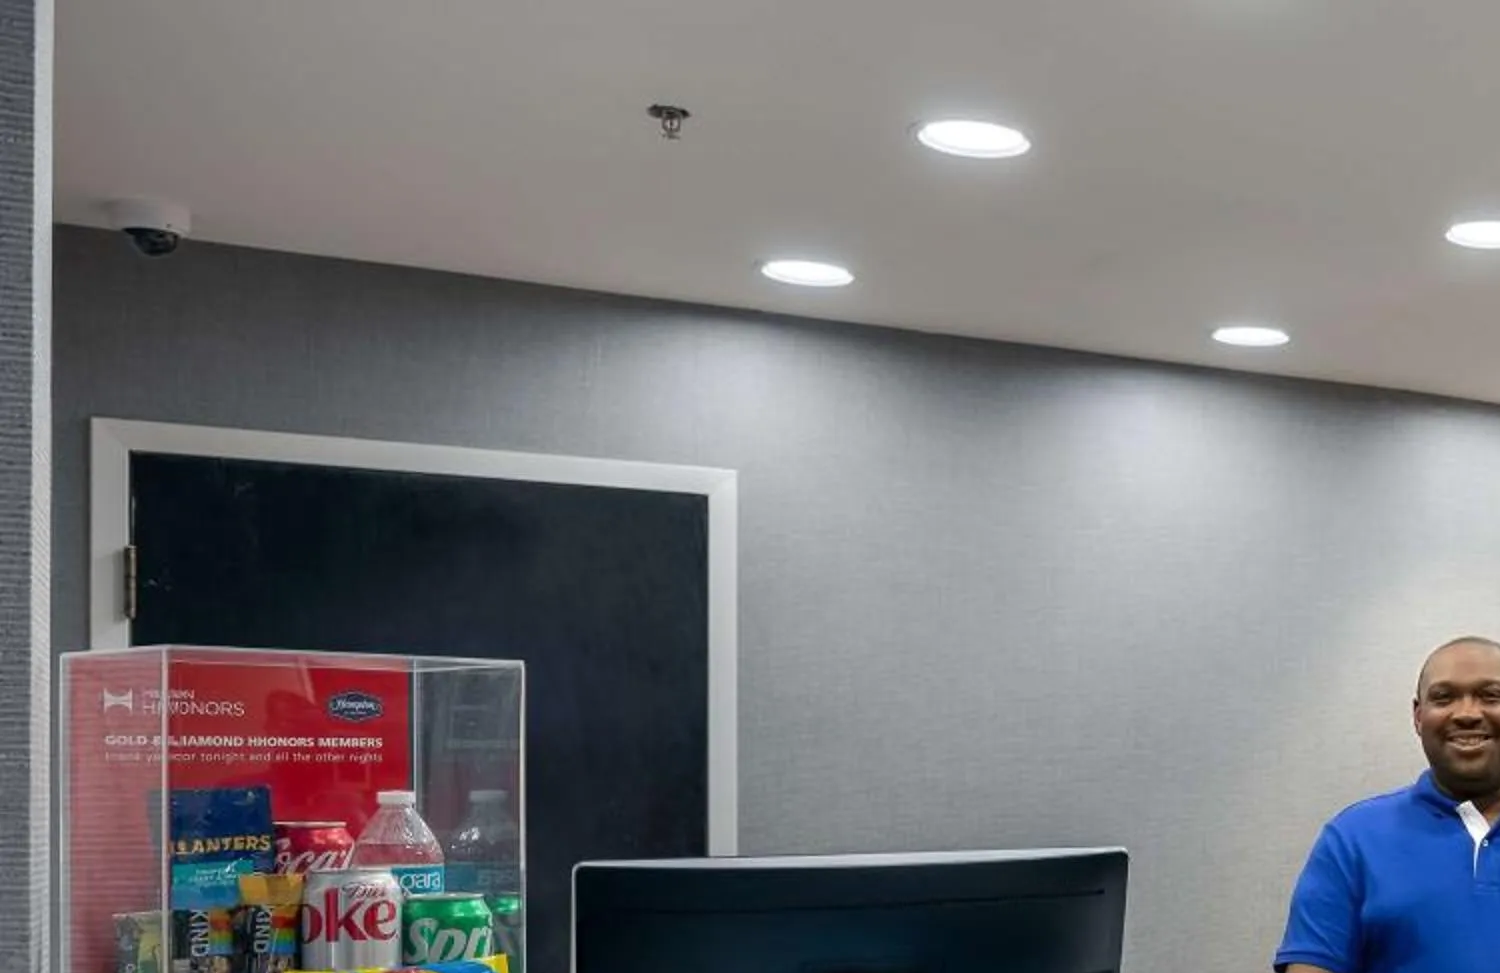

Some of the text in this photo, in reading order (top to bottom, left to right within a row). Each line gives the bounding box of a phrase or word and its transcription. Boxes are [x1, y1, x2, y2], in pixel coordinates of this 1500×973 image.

[105, 735, 147, 746] GOLD
[247, 736, 315, 748] HHONORS
[317, 737, 384, 748] MEMBERS
[191, 908, 211, 957] KIND
